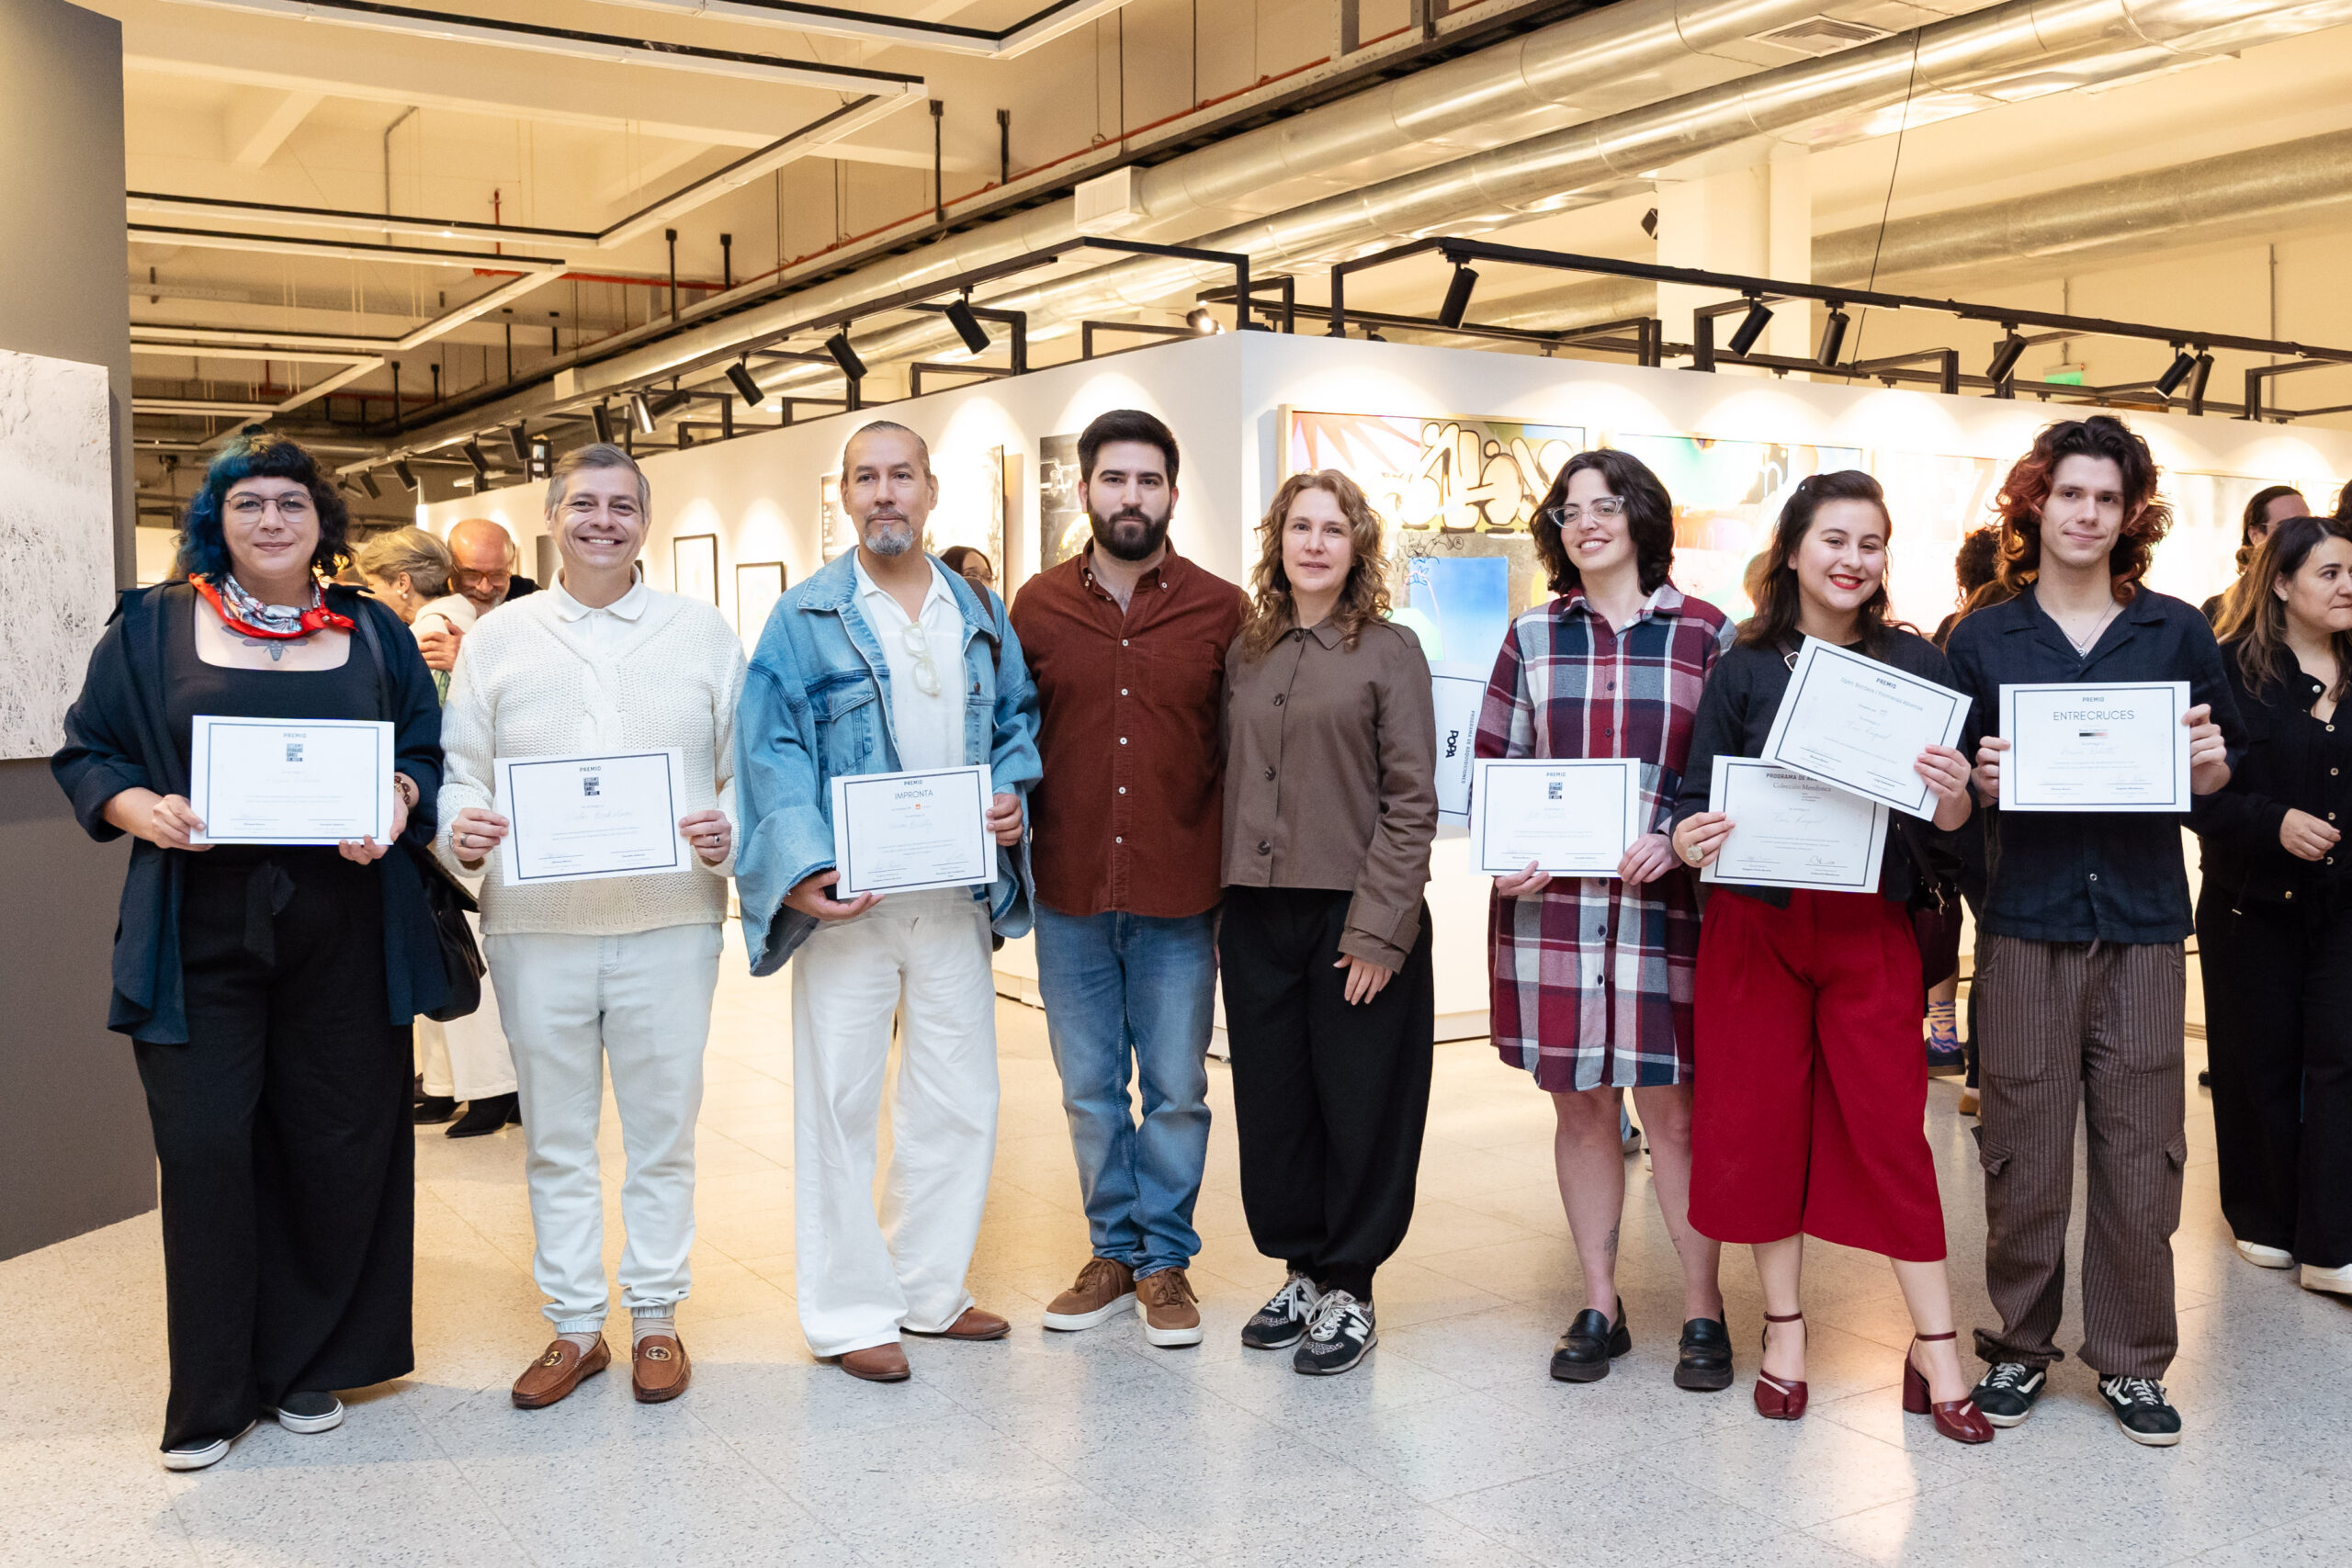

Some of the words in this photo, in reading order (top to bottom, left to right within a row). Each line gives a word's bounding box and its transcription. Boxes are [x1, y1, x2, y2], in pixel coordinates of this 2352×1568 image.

[1877, 677, 1897, 689] PREMIO
[2053, 710, 2135, 721] ENTRECRUCES
[1446, 730, 1459, 758] POPA
[894, 790, 934, 800] IMPRONTA
